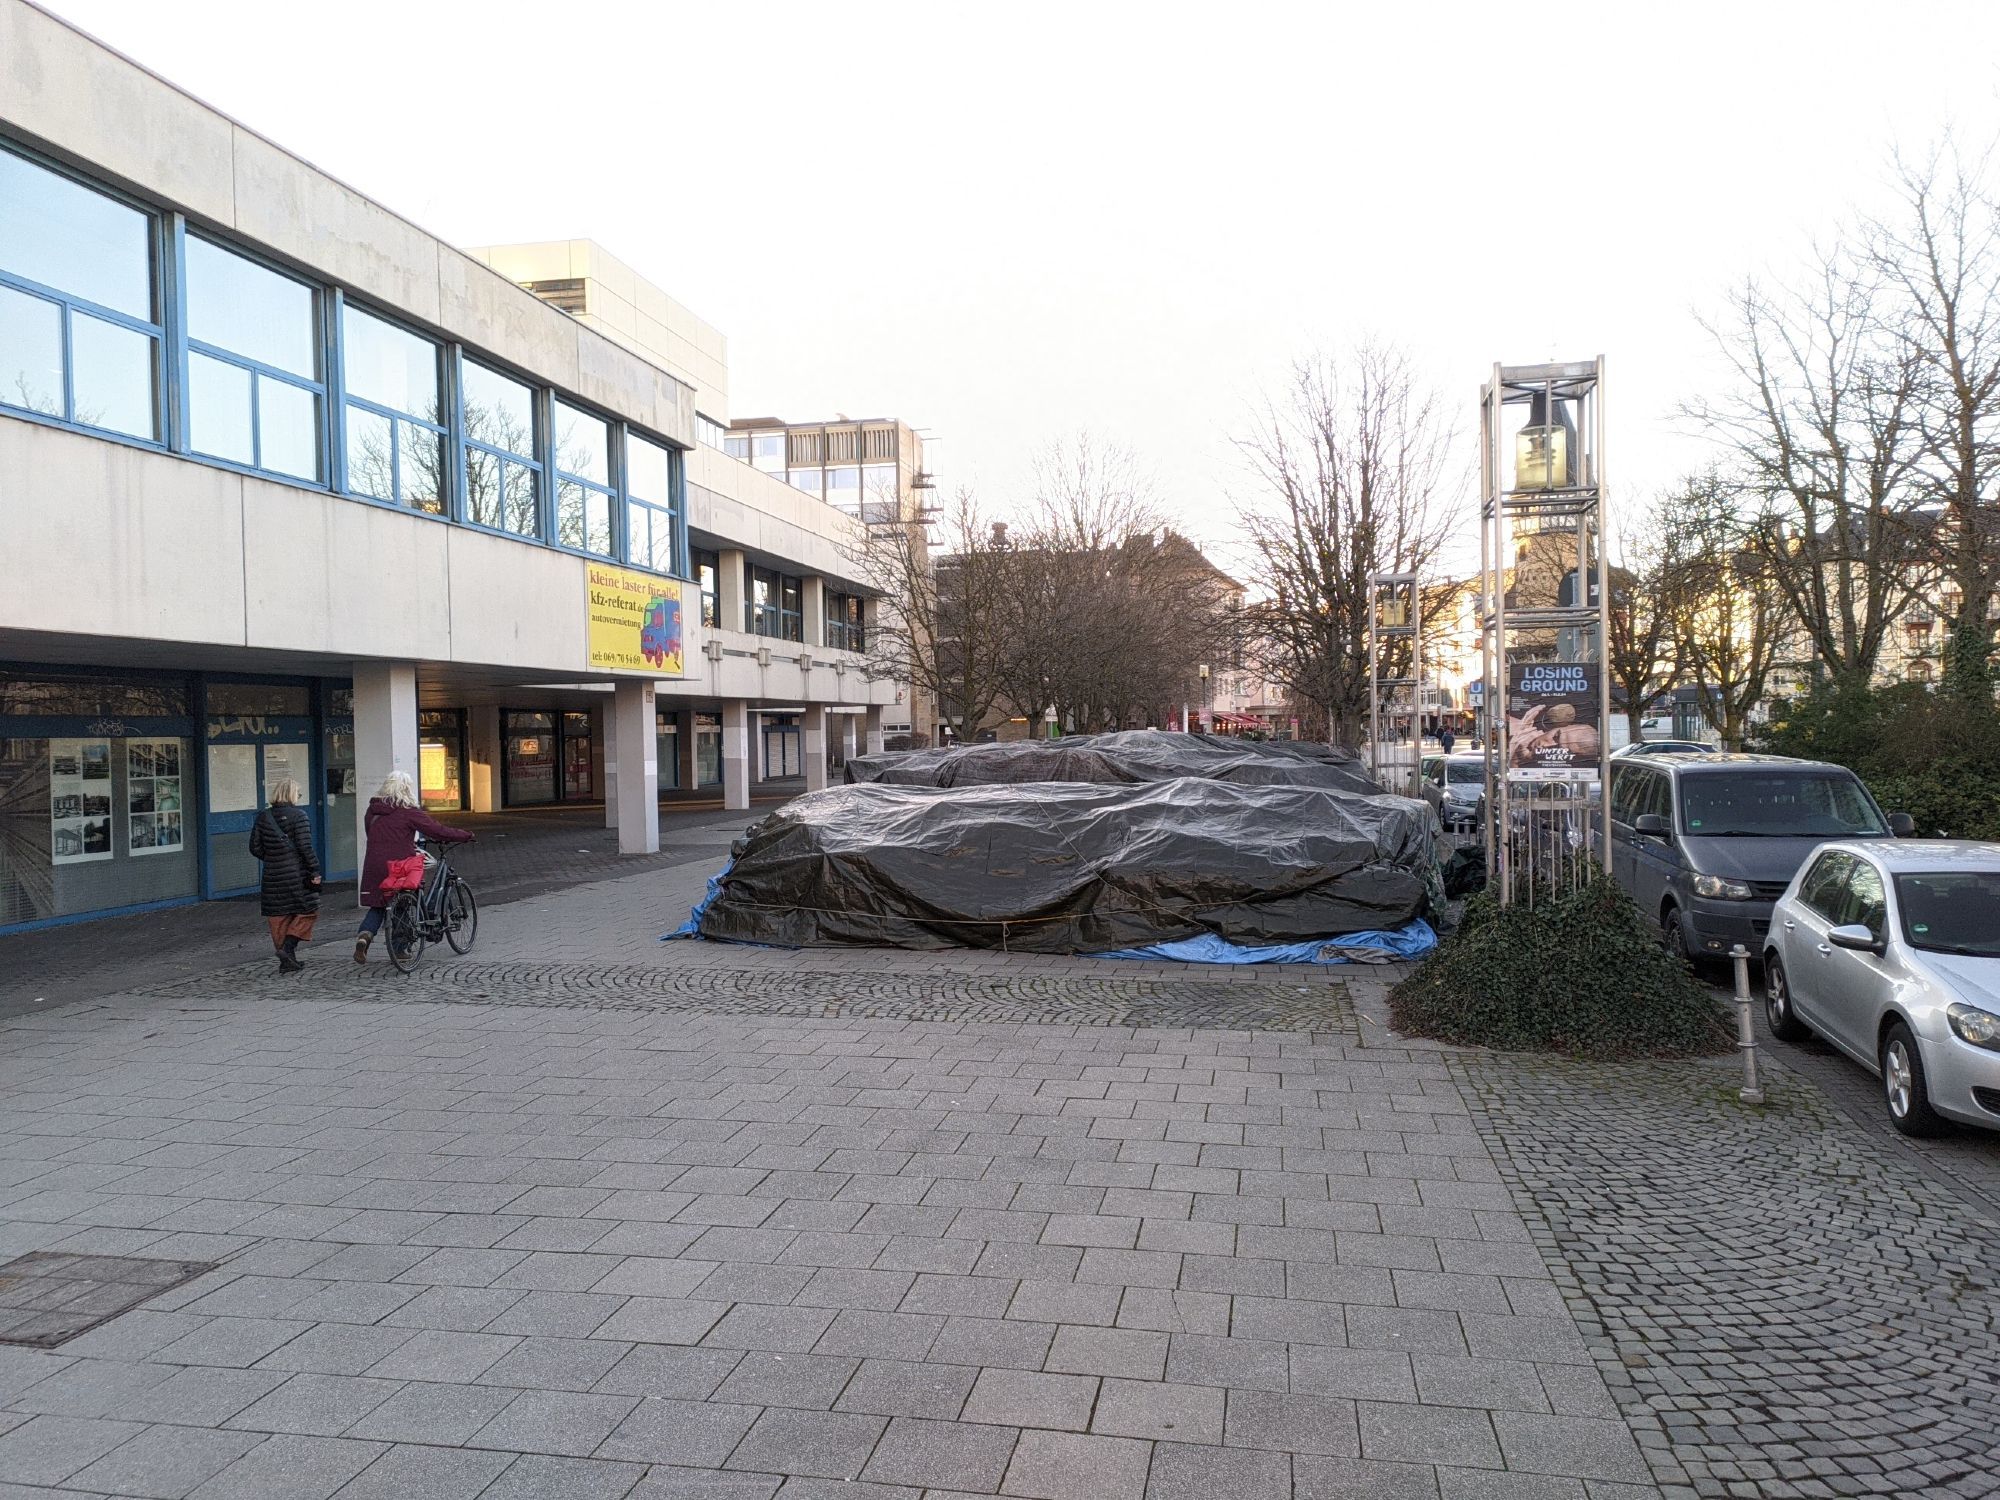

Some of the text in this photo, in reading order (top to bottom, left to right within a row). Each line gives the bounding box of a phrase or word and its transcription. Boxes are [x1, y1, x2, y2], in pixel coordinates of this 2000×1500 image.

[590, 570, 619, 588] kleine
[622, 577, 646, 594] laster
[648, 583, 661, 596] für
[592, 615, 641, 629] autovermietung
[1525, 667, 1583, 678] LOSING
[1470, 682, 1482, 693] U
[1520, 680, 1587, 691] GROUND
